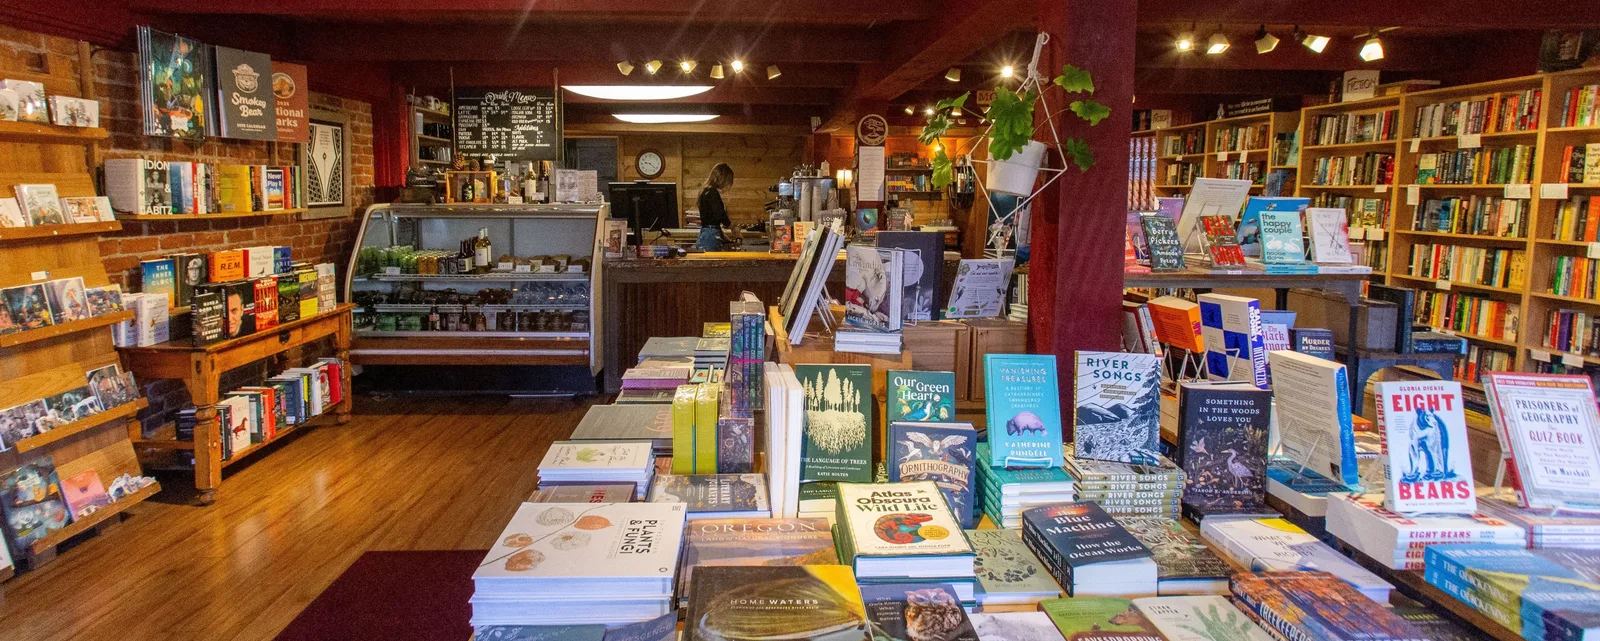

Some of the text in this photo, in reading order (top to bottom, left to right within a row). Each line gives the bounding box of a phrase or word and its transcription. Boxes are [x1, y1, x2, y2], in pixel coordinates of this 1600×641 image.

[232, 92, 266, 108] Smokey
[240, 105, 262, 117] Bear
[276, 107, 304, 118] tional
[276, 118, 298, 127] arks
[144, 160, 170, 170] IDION
[164, 184, 171, 193] &
[1152, 228, 1174, 237] Berry
[1151, 236, 1179, 245] Pickers
[1248, 306, 1258, 342] ROONEY
[1302, 337, 1330, 345] MURDER
[1087, 358, 1128, 369] RIVER
[1253, 347, 1266, 386] INTERMEZZO
[1094, 370, 1142, 381] SONGS
[894, 376, 950, 393] Our Green
[902, 390, 933, 400] Heart
[1392, 394, 1454, 412] EIGHT
[1516, 399, 1569, 412] PRISONERS
[1522, 412, 1579, 424] GEOGRAPHY
[1376, 394, 1388, 456] EIGHT BEARS
[1529, 431, 1584, 444] QUIZ BOOK
[901, 462, 969, 479] ORNITHOGRAPHY
[1560, 468, 1590, 477] Marshall
[1398, 481, 1470, 500] BEARS
[904, 503, 938, 511] Life
[1054, 515, 1091, 524] Blue
[702, 523, 815, 533] OREGON
[1046, 521, 1116, 535] Machine
[620, 527, 640, 554] FUNGI
[636, 520, 658, 554] PLANTS
[1069, 545, 1142, 559] Ocean Works
